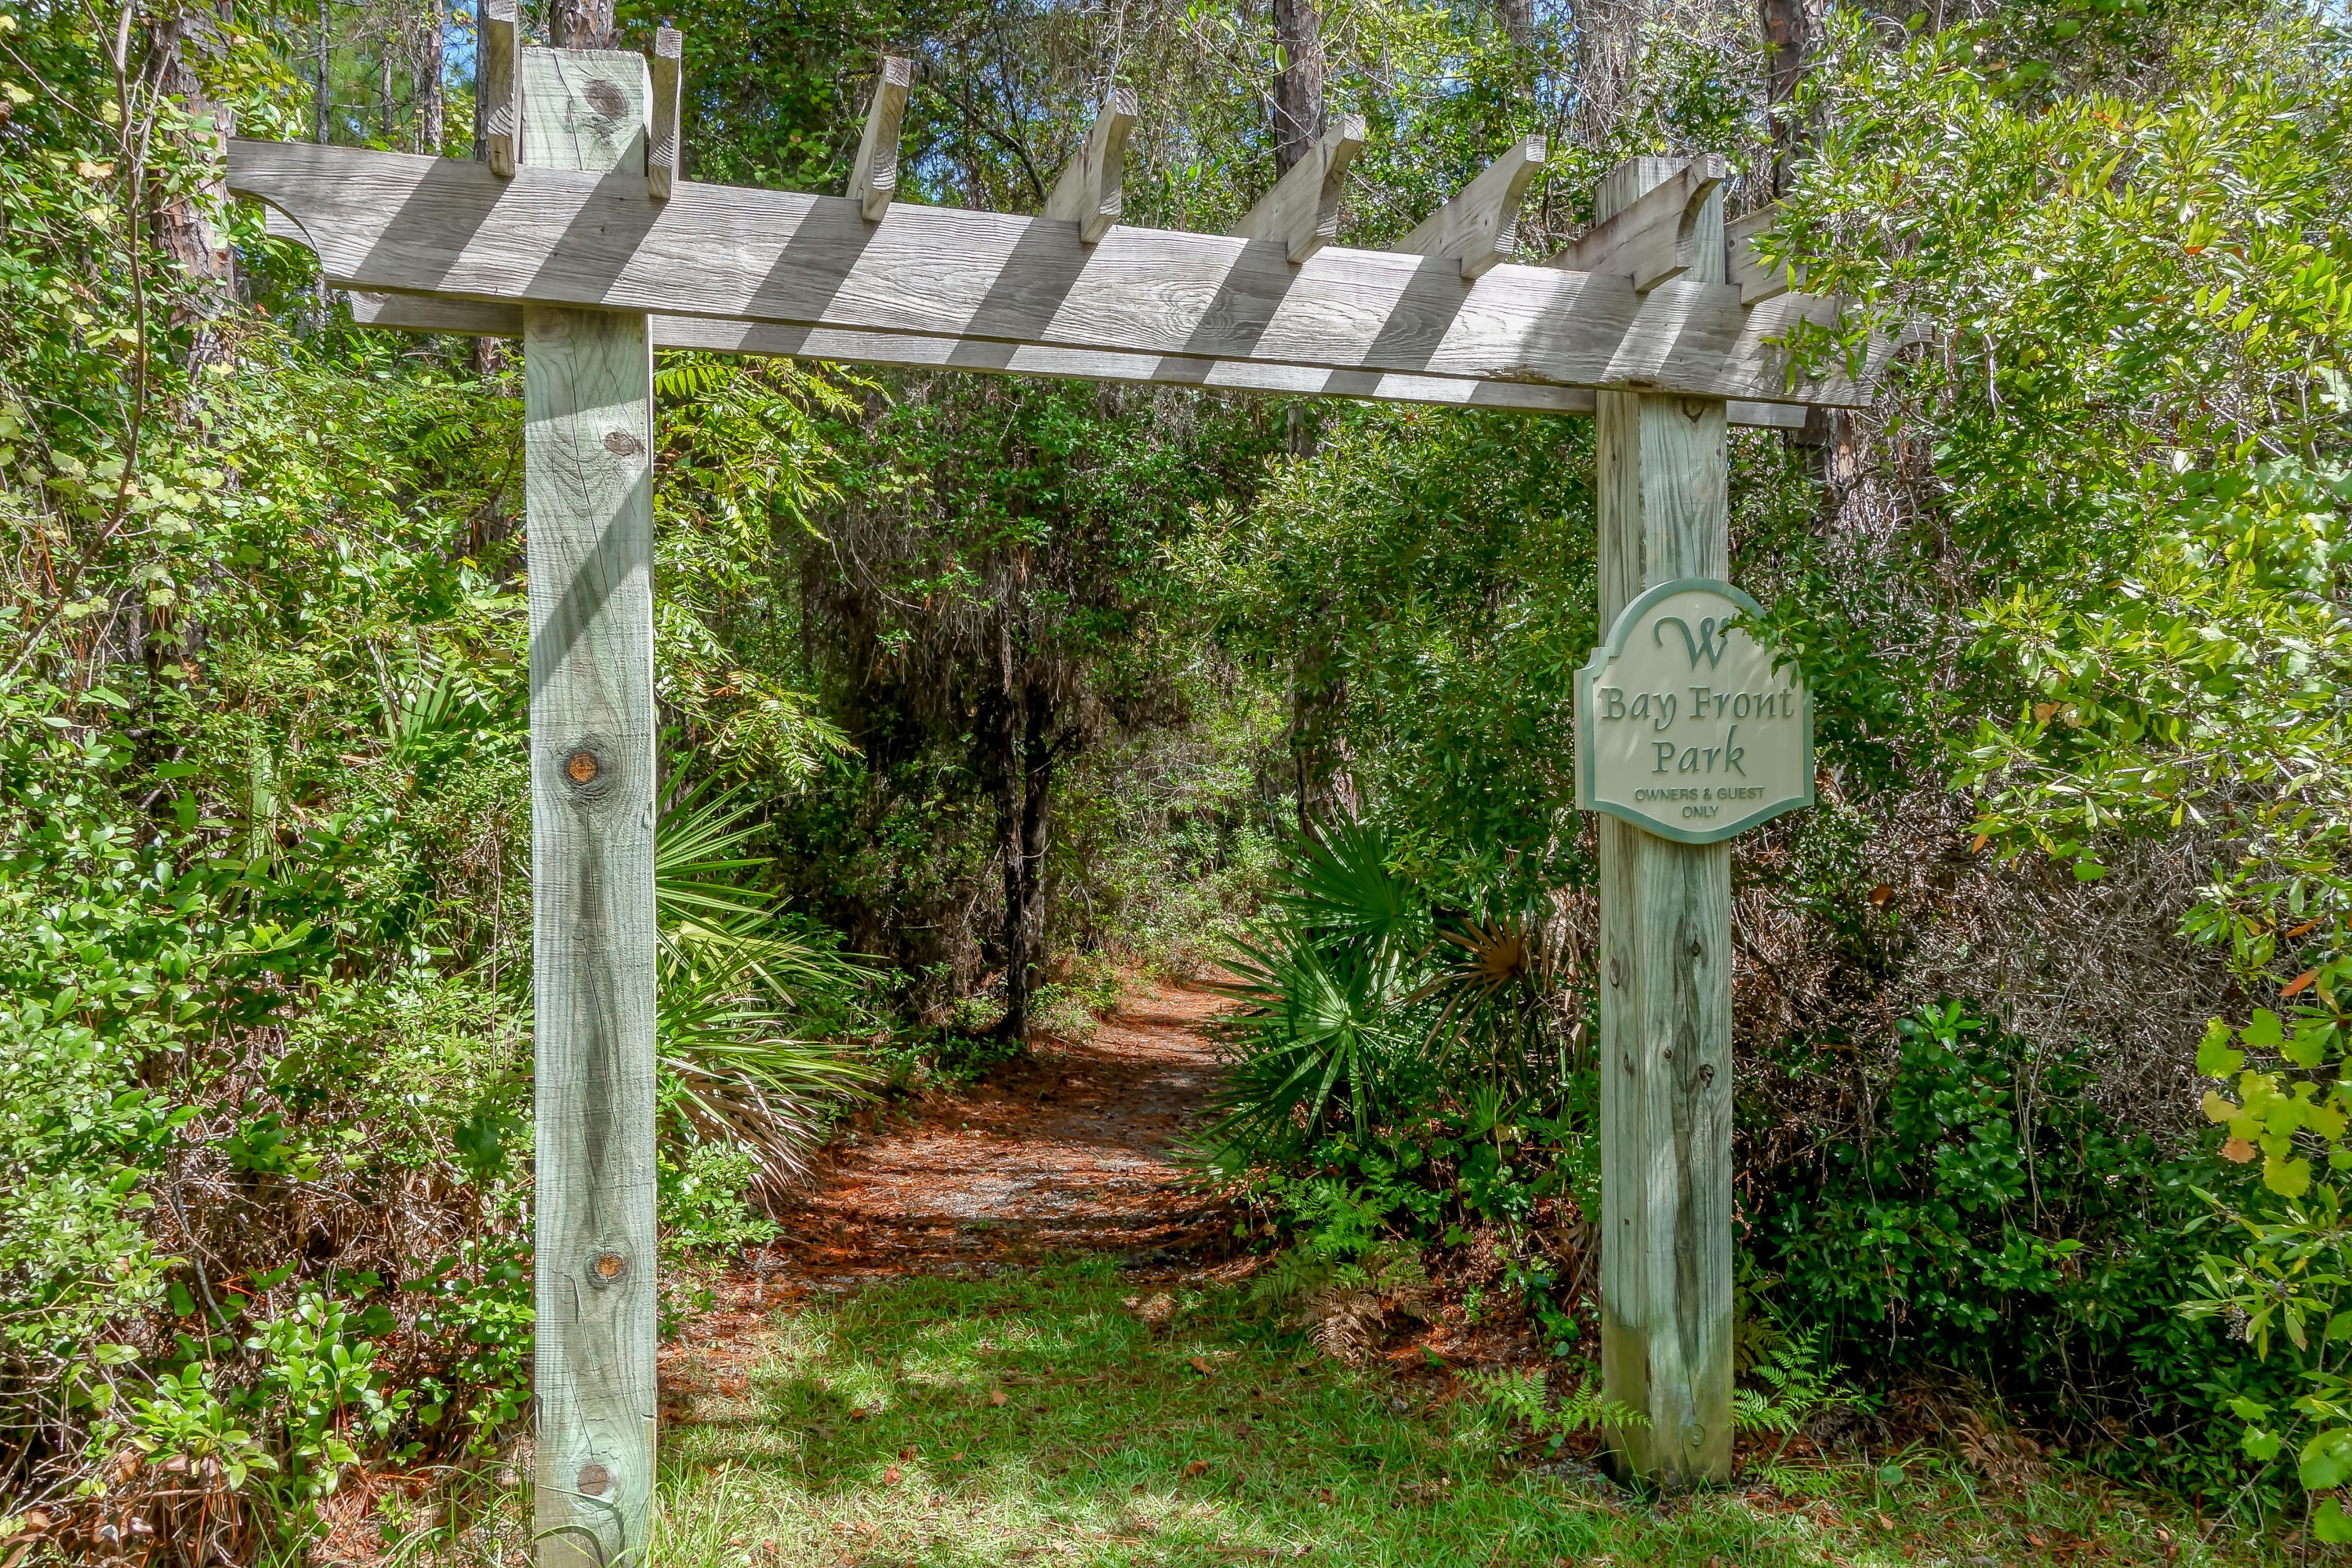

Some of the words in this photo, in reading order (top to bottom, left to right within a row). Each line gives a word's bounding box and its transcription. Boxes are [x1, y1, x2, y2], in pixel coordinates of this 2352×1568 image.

[1653, 615, 1730, 672] W
[1599, 686, 1678, 731] Bay
[1689, 686, 1795, 720] Front
[1651, 724, 1747, 778] Park
[1635, 787, 1698, 801] OWNERS
[1703, 787, 1713, 800] &
[1717, 786, 1766, 800] GUEST
[1682, 805, 1719, 818] ONLY
